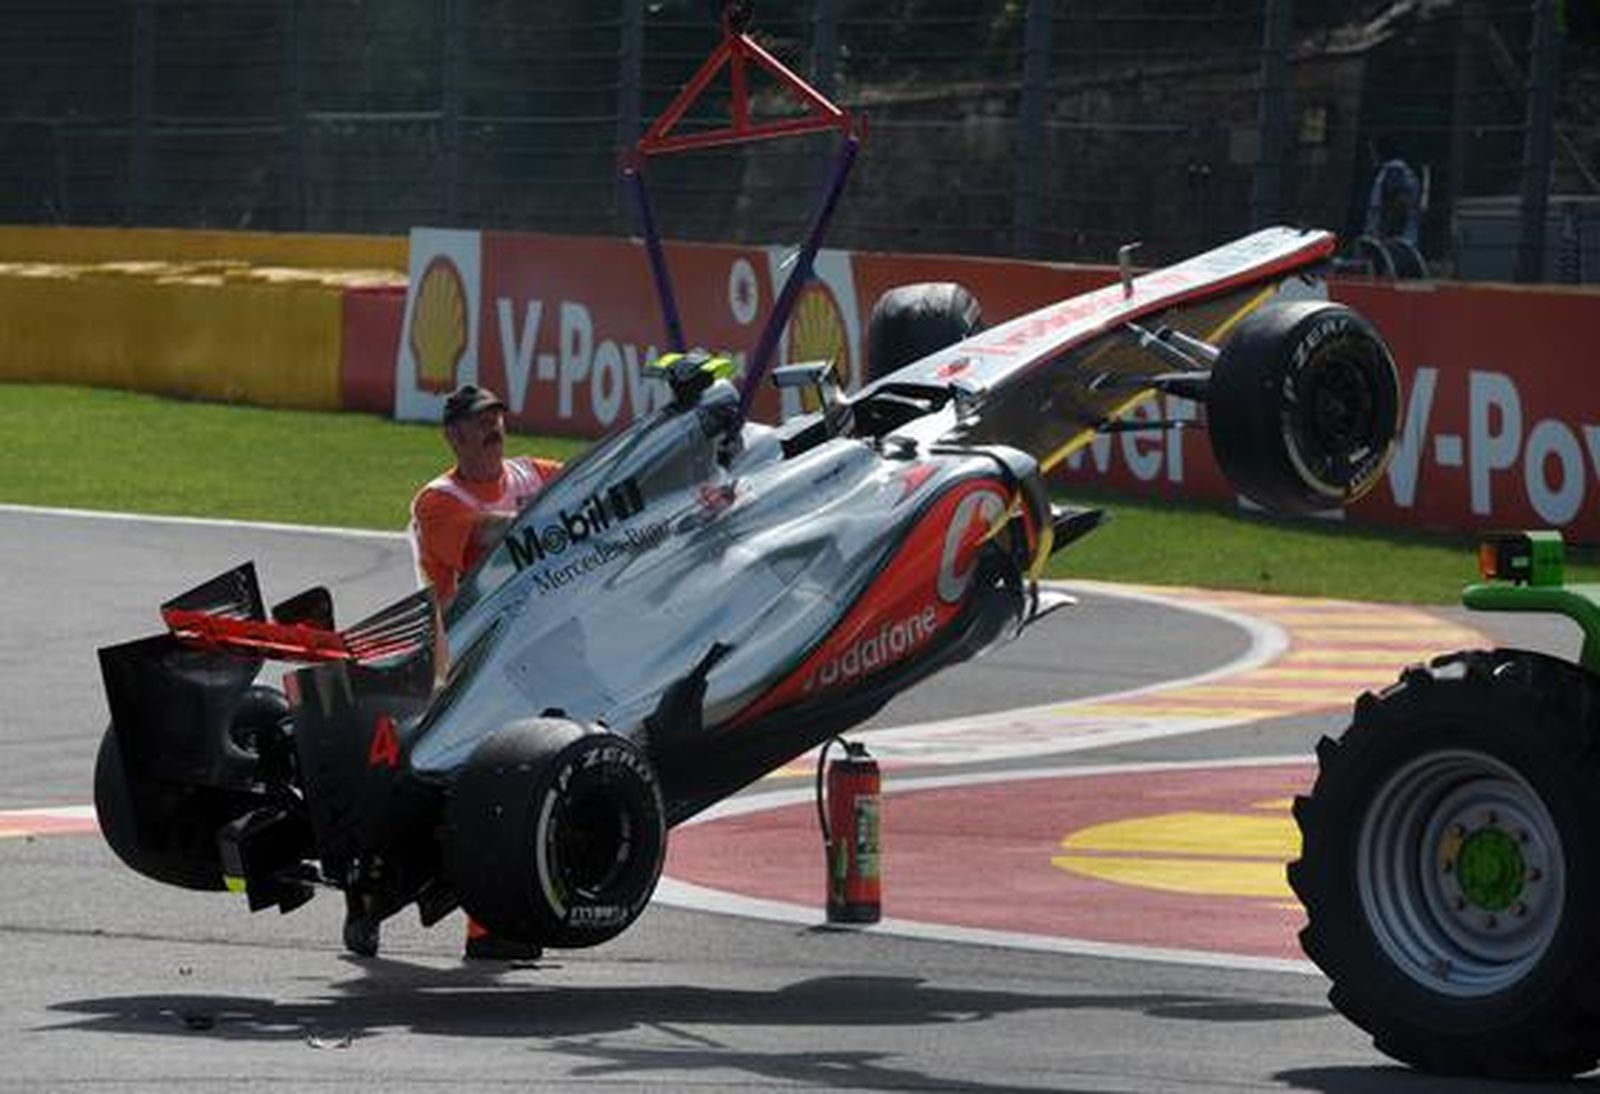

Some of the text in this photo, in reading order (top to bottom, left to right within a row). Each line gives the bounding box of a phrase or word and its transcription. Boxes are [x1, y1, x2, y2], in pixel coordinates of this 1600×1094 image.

[498, 297, 746, 425] V-Pow
[1387, 367, 1600, 526] V-Po
[504, 493, 610, 572] Mobil
